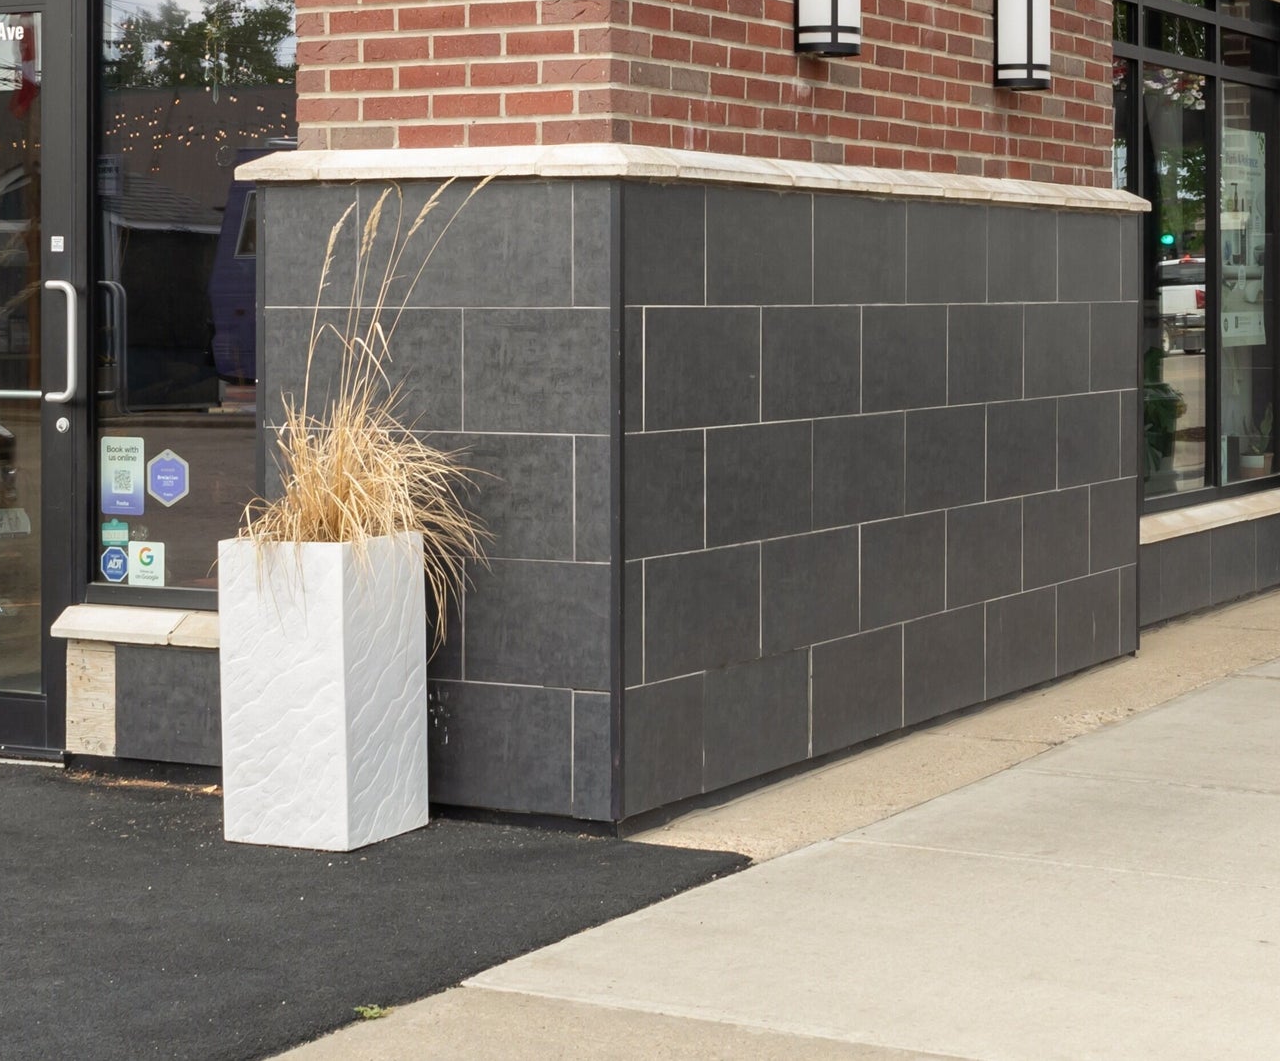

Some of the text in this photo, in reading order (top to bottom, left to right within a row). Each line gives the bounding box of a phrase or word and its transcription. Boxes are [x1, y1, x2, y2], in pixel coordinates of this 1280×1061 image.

[106, 445, 139, 454] Book with
[117, 454, 137, 462] online
[139, 546, 154, 567] G
[106, 558, 124, 570] ADT
